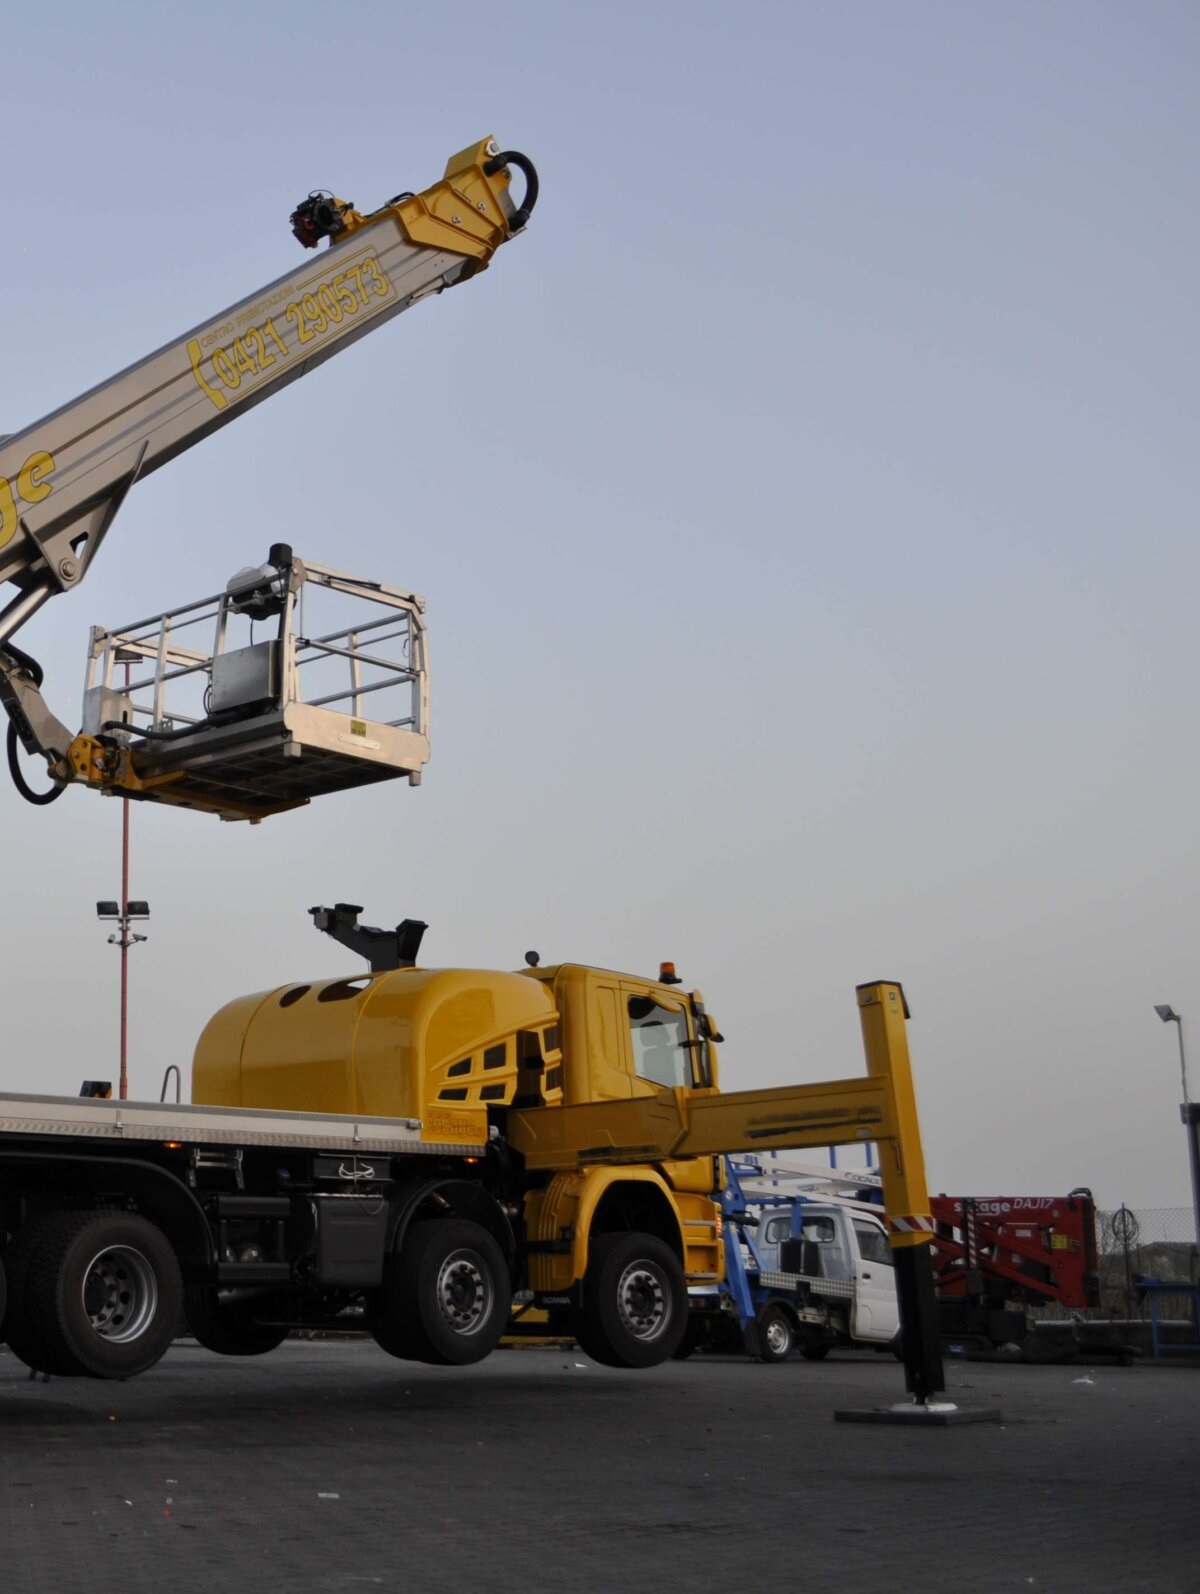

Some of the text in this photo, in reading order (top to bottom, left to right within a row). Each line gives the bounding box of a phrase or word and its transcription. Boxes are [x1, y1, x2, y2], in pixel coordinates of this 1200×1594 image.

[211, 257, 389, 389] 0421 290573
[954, 1201, 1011, 1216] sage
